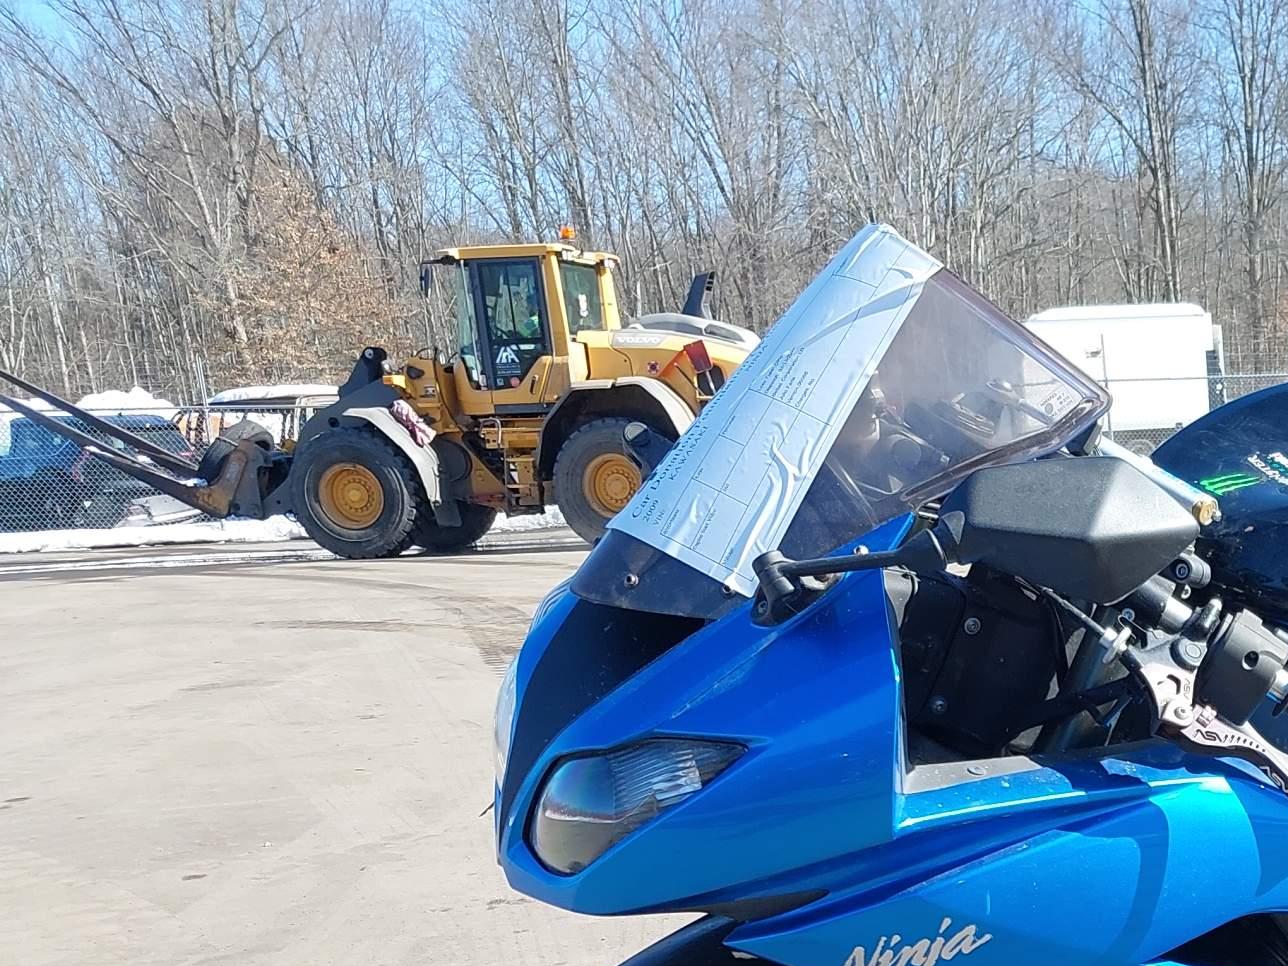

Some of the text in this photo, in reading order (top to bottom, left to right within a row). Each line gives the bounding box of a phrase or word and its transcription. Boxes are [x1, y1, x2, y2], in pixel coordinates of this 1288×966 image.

[616, 336, 661, 344] VOLVO
[632, 492, 651, 519] Car
[650, 432, 695, 491] Donation
[643, 499, 659, 522] 2009
[669, 426, 708, 481] KAWASAKI
[1194, 728, 1229, 744] ASV
